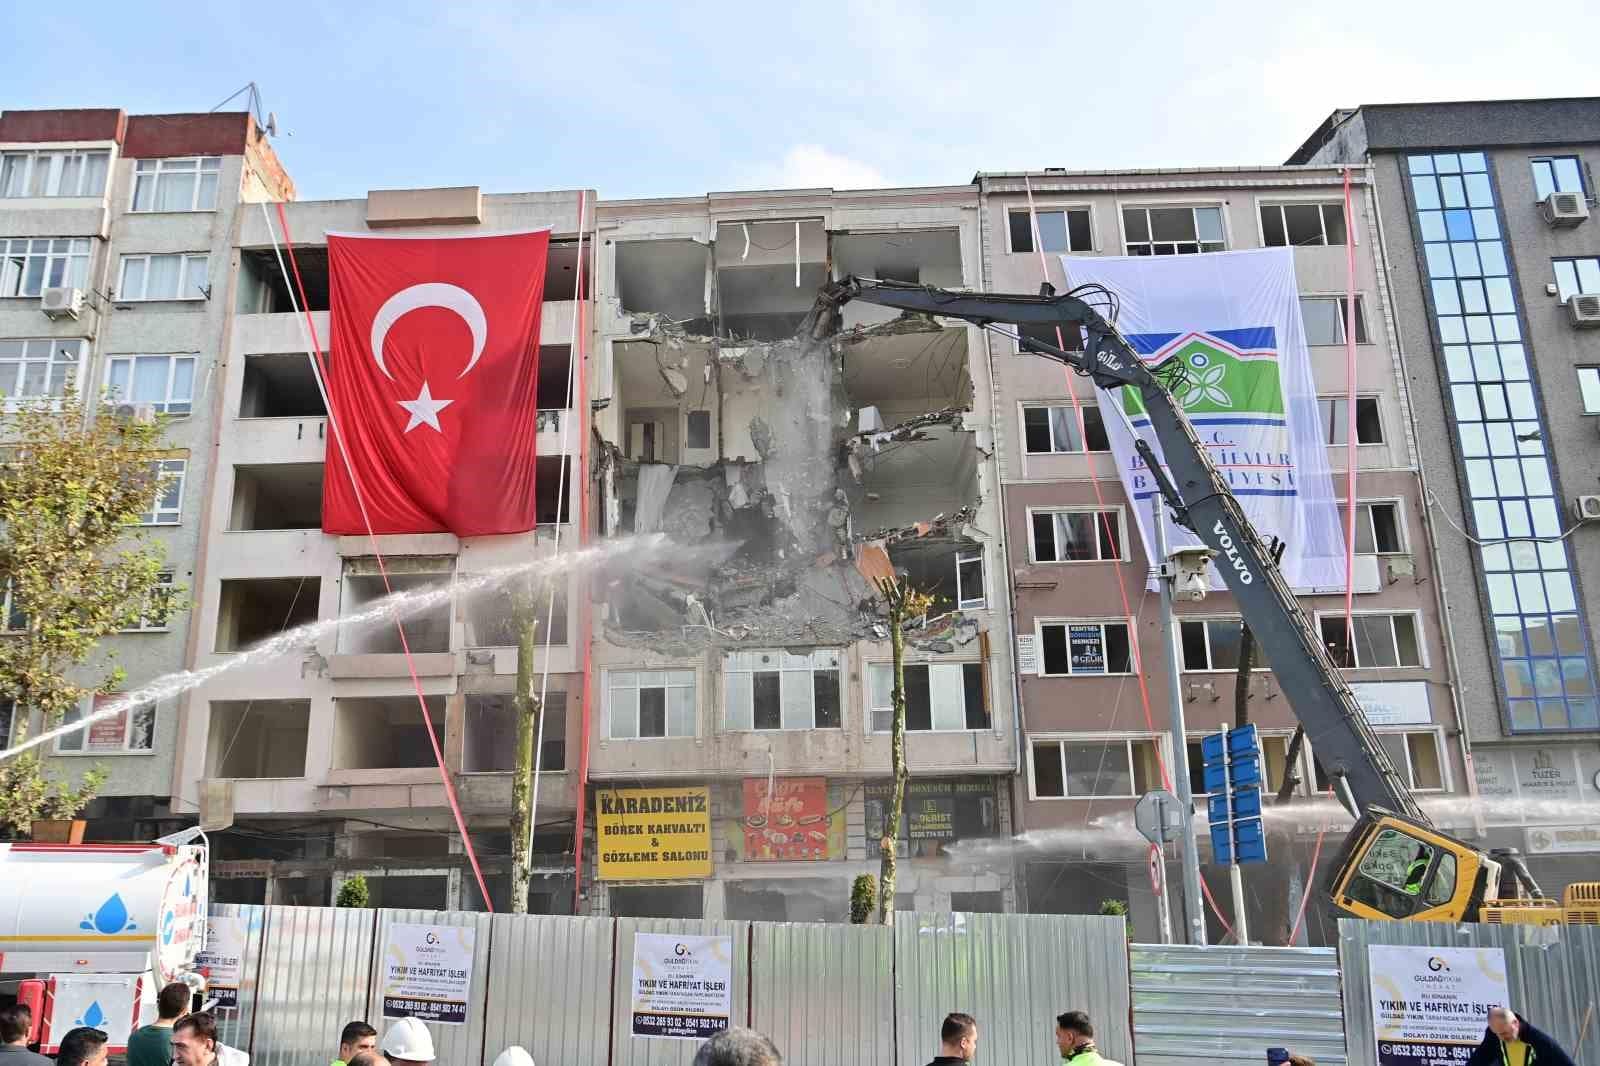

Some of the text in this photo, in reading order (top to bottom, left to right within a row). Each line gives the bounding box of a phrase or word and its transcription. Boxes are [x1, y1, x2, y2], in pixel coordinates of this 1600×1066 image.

[1213, 520, 1253, 585] VOLVO
[601, 792, 706, 815] KARADENİZ
[604, 823, 706, 836] BÖREK KAHVALTI
[651, 837, 660, 848] &
[603, 850, 709, 863] GÖZLEME SALONU
[639, 979, 656, 988] YIKIM
[659, 980, 667, 988] VE
[1379, 999, 1407, 1012] YIKIM
[1410, 1001, 1422, 1012] VE
[1424, 1000, 1469, 1014] HAFRİYAT
[674, 1018, 682, 1027] 02
[685, 1019, 699, 1028] 0541
[1392, 1045, 1410, 1056] 0532
[1412, 1046, 1425, 1057] 265
[1427, 1046, 1437, 1058] 93
[1437, 1047, 1447, 1057] 02
[1452, 1047, 1471, 1059] 0541
